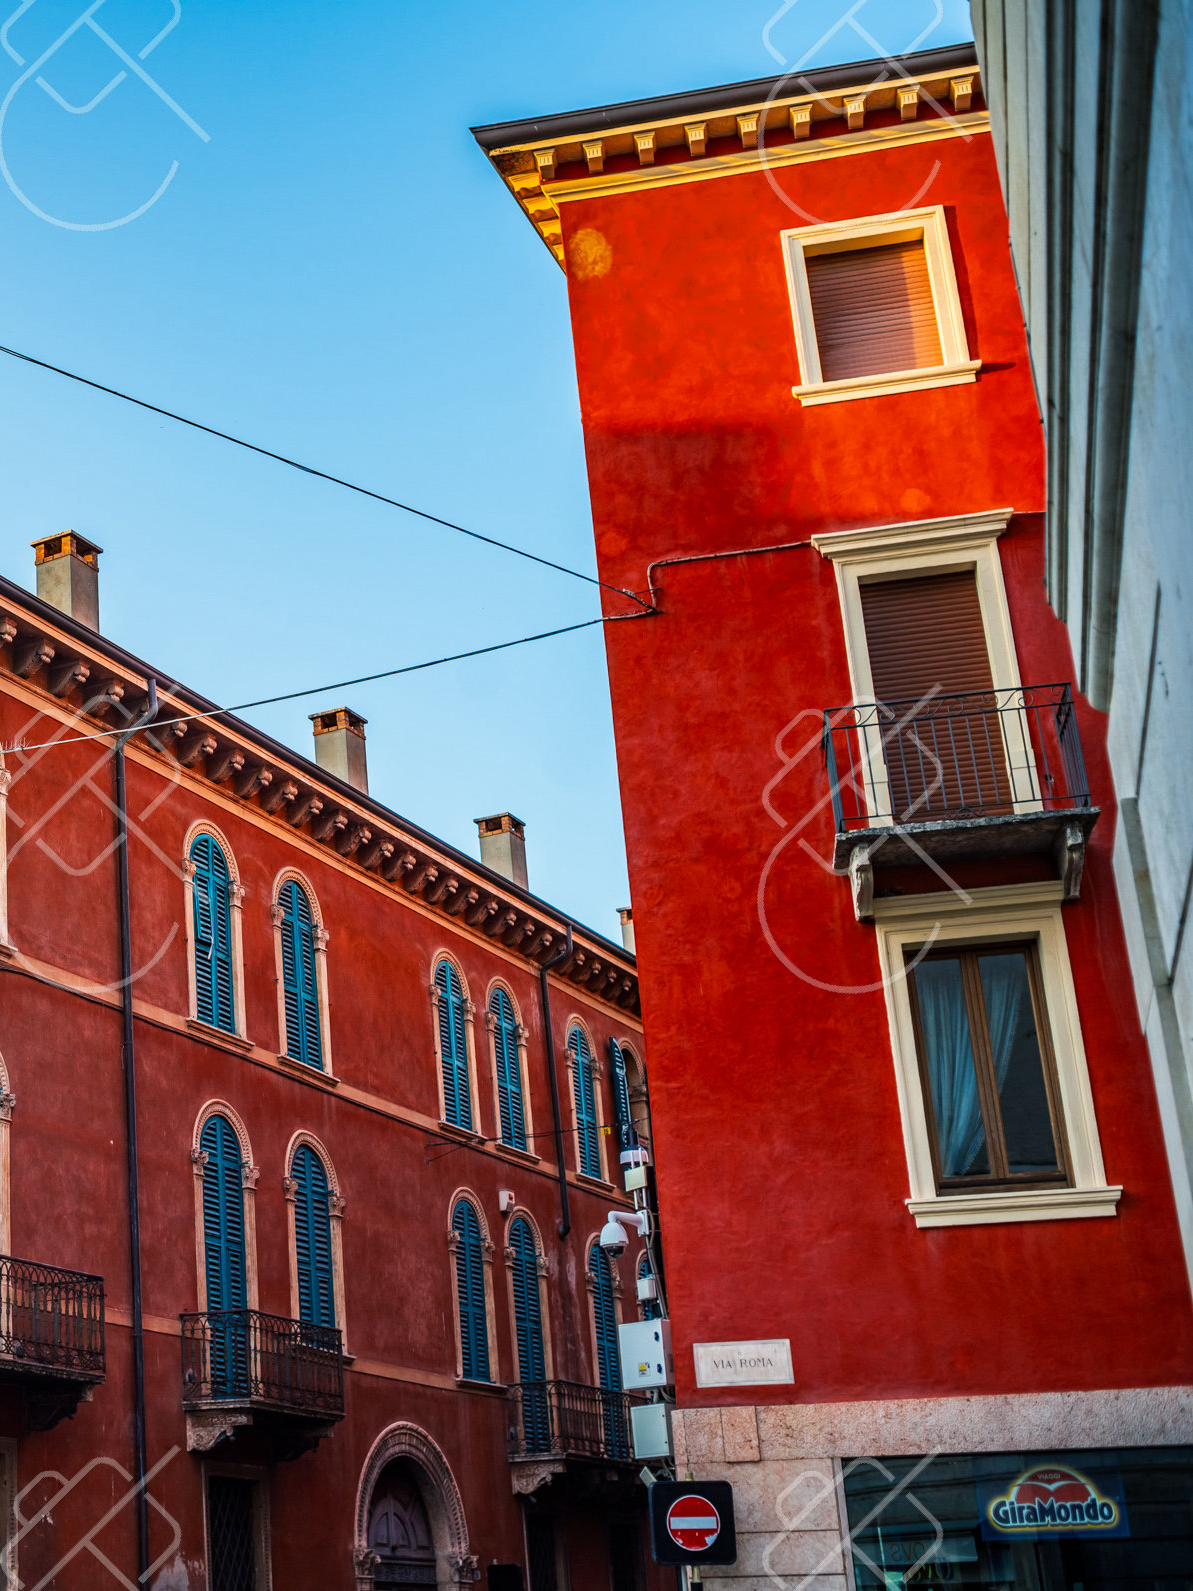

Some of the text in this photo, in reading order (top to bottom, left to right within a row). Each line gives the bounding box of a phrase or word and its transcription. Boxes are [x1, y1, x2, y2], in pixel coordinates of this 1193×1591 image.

[713, 1358, 774, 1369] VIA ROMA
[991, 1497, 1115, 1527] GiraMondo
